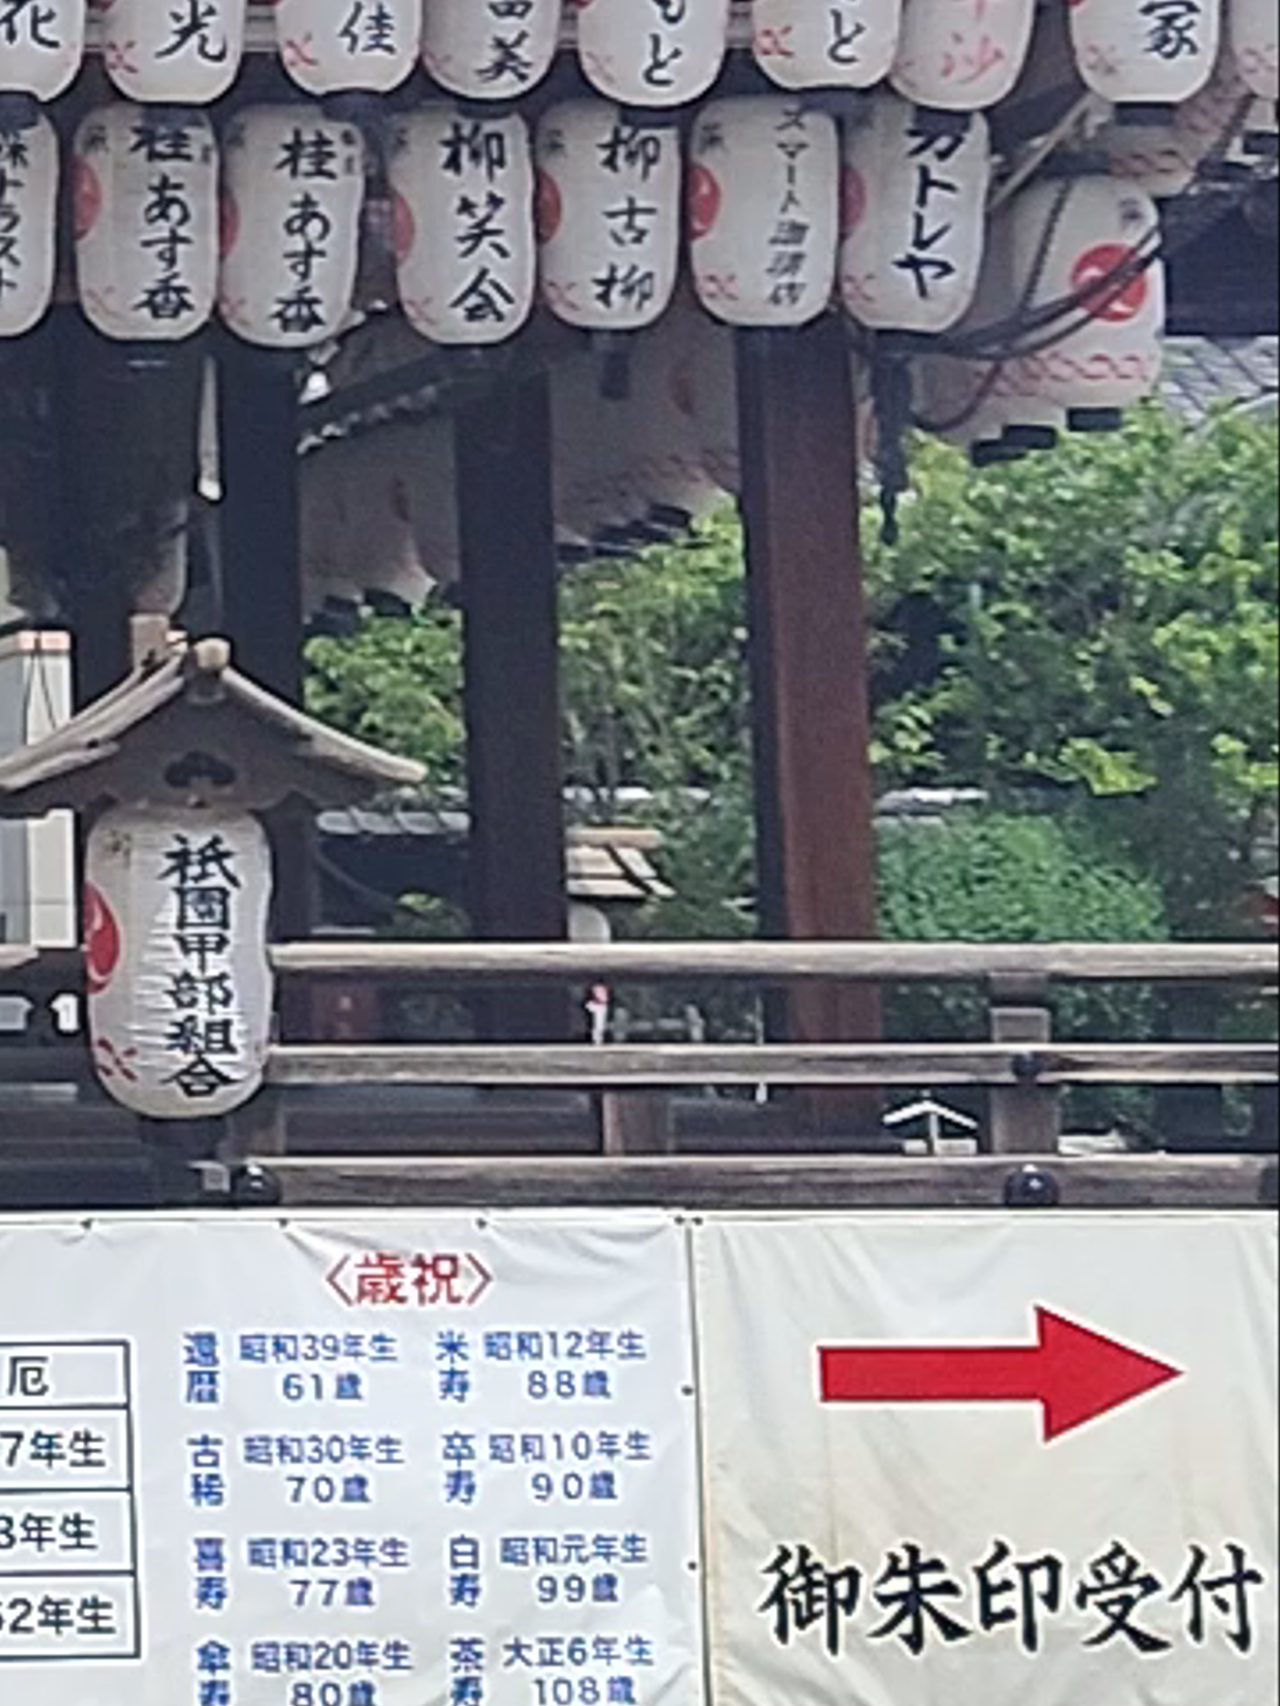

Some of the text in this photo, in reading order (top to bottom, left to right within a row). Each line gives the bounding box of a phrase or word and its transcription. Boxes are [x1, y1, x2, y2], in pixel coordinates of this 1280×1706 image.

[892, 129, 966, 300] カトレヤ
[238, 1332, 398, 1365] 昭和39年生
[483, 1329, 647, 1362] 昭和12年生
[281, 1371, 363, 1402] 61歳
[527, 1369, 612, 1400] 88歳
[242, 1433, 405, 1466] 昭和30年生
[488, 1429, 652, 1465] 昭和10年生
[285, 1473, 371, 1504] 70歳
[530, 1469, 619, 1502] 90歳
[246, 1536, 410, 1569] 昭和23年生
[499, 1532, 647, 1567] 昭和元年生
[289, 1576, 375, 1607] 77歳
[536, 1572, 619, 1604] 99歳
[759, 1539, 1264, 1657] 御朱印受付
[250, 1639, 414, 1674] 昭和20年生
[502, 1635, 654, 1668] 大正6年生
[533, 1674, 638, 1706] 108歳
